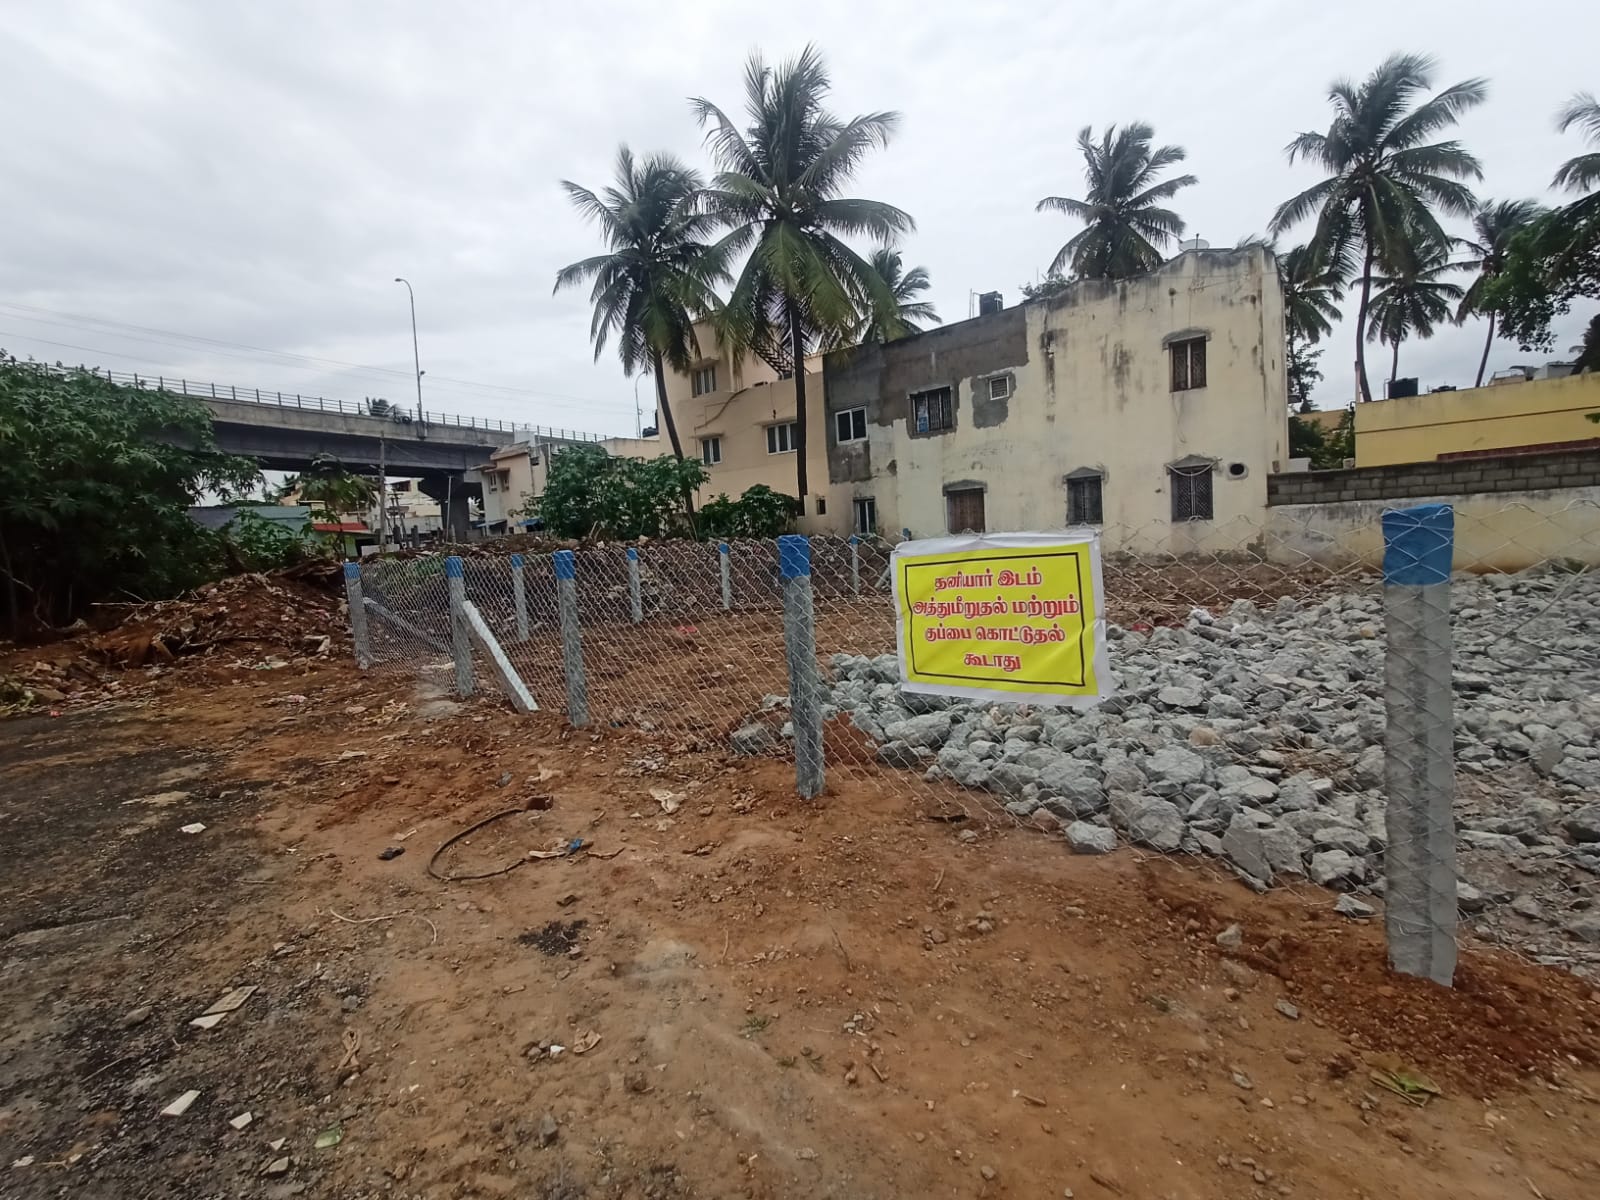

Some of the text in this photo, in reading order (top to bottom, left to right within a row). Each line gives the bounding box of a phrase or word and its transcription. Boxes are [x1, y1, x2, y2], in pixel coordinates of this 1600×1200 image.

[934, 566, 1042, 592] தனியார் இடம்
[912, 594, 1079, 619] அத்துமீறுதல் மற்றும்
[976, 623, 1066, 645] கொட்டுதல்
[963, 653, 1021, 672] கூடாது
